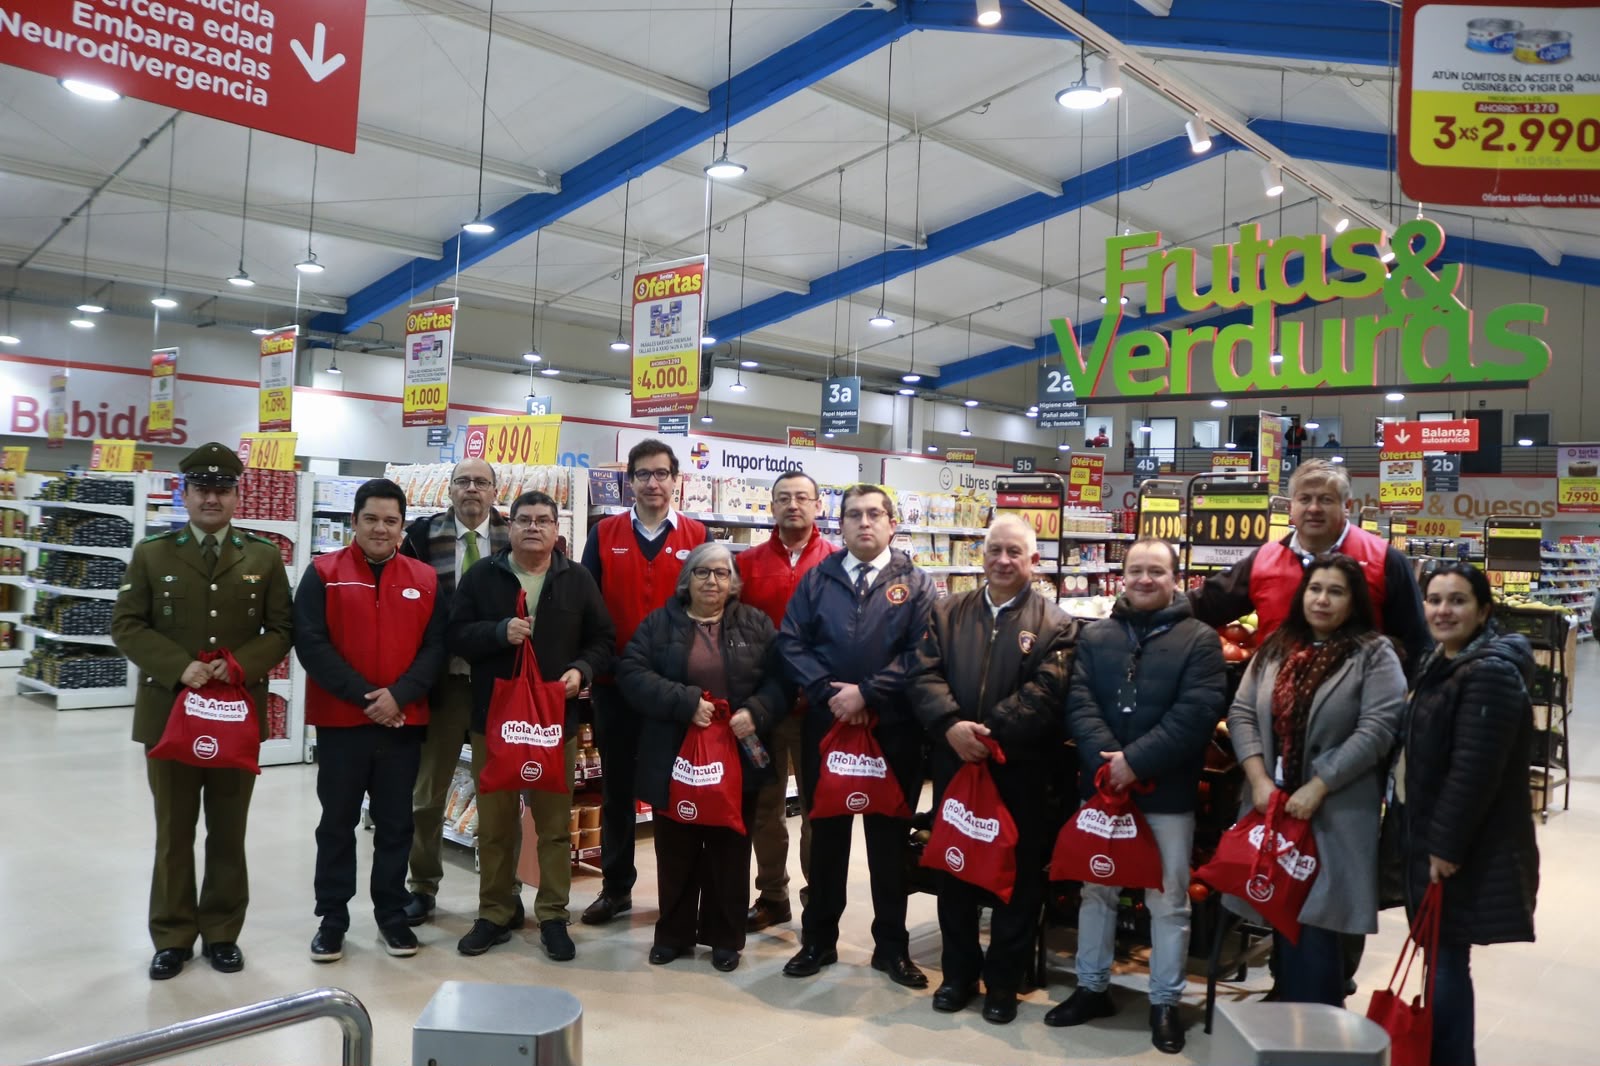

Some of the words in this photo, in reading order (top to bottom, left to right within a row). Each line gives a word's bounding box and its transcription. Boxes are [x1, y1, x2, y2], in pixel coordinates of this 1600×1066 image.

[186, 0, 275, 29] ucida
[72, 1, 271, 80] Embarazadas
[203, 19, 273, 55] edad
[0, 8, 268, 106] Neurodivergencia
[1461, 72, 1506, 82] LOMITOS
[1509, 73, 1521, 82] EN
[1525, 74, 1561, 83] ACEITE
[1564, 75, 1573, 83] O
[1576, 75, 1600, 83] AGU
[1462, 82, 1526, 93] CUISINE&CO
[1529, 84, 1557, 93] 91GR
[1559, 84, 1574, 93] DR
[1482, 193, 1511, 203] Ofertas
[1543, 194, 1567, 203] desde
[1104, 223, 1387, 315] Frutas
[1384, 219, 1466, 314] &
[635, 273, 702, 301] Ofertas
[407, 313, 452, 332] Ofertas
[1049, 299, 1552, 397] Verduras
[1046, 371, 1075, 392] 2a
[829, 383, 852, 403] 3a
[530, 402, 546, 416] 5a
[10, 395, 188, 445] Bbids
[1421, 427, 1470, 437] Balanza
[497, 425, 532, 463] 990
[791, 436, 814, 446] Ofertas
[722, 449, 803, 473] Importados
[946, 452, 975, 461] Ofertas
[1072, 456, 1103, 467] Ofertas
[1213, 456, 1249, 466] Ofertas
[1380, 451, 1423, 460] Ofertas
[1017, 460, 1032, 471] 5b
[1137, 459, 1155, 472] 4b
[1432, 459, 1454, 471] 2b
[960, 473, 989, 491] Libres
[1021, 494, 1053, 504] Ofertas
[1427, 494, 1445, 516] &
[1453, 494, 1556, 520] Quesos
[1211, 514, 1267, 540] 1.990
[1424, 520, 1446, 535] 499
[1215, 548, 1244, 556] TOMATE
[504, 723, 532, 735] ¡Hola
[830, 753, 857, 765] ¡Hola
